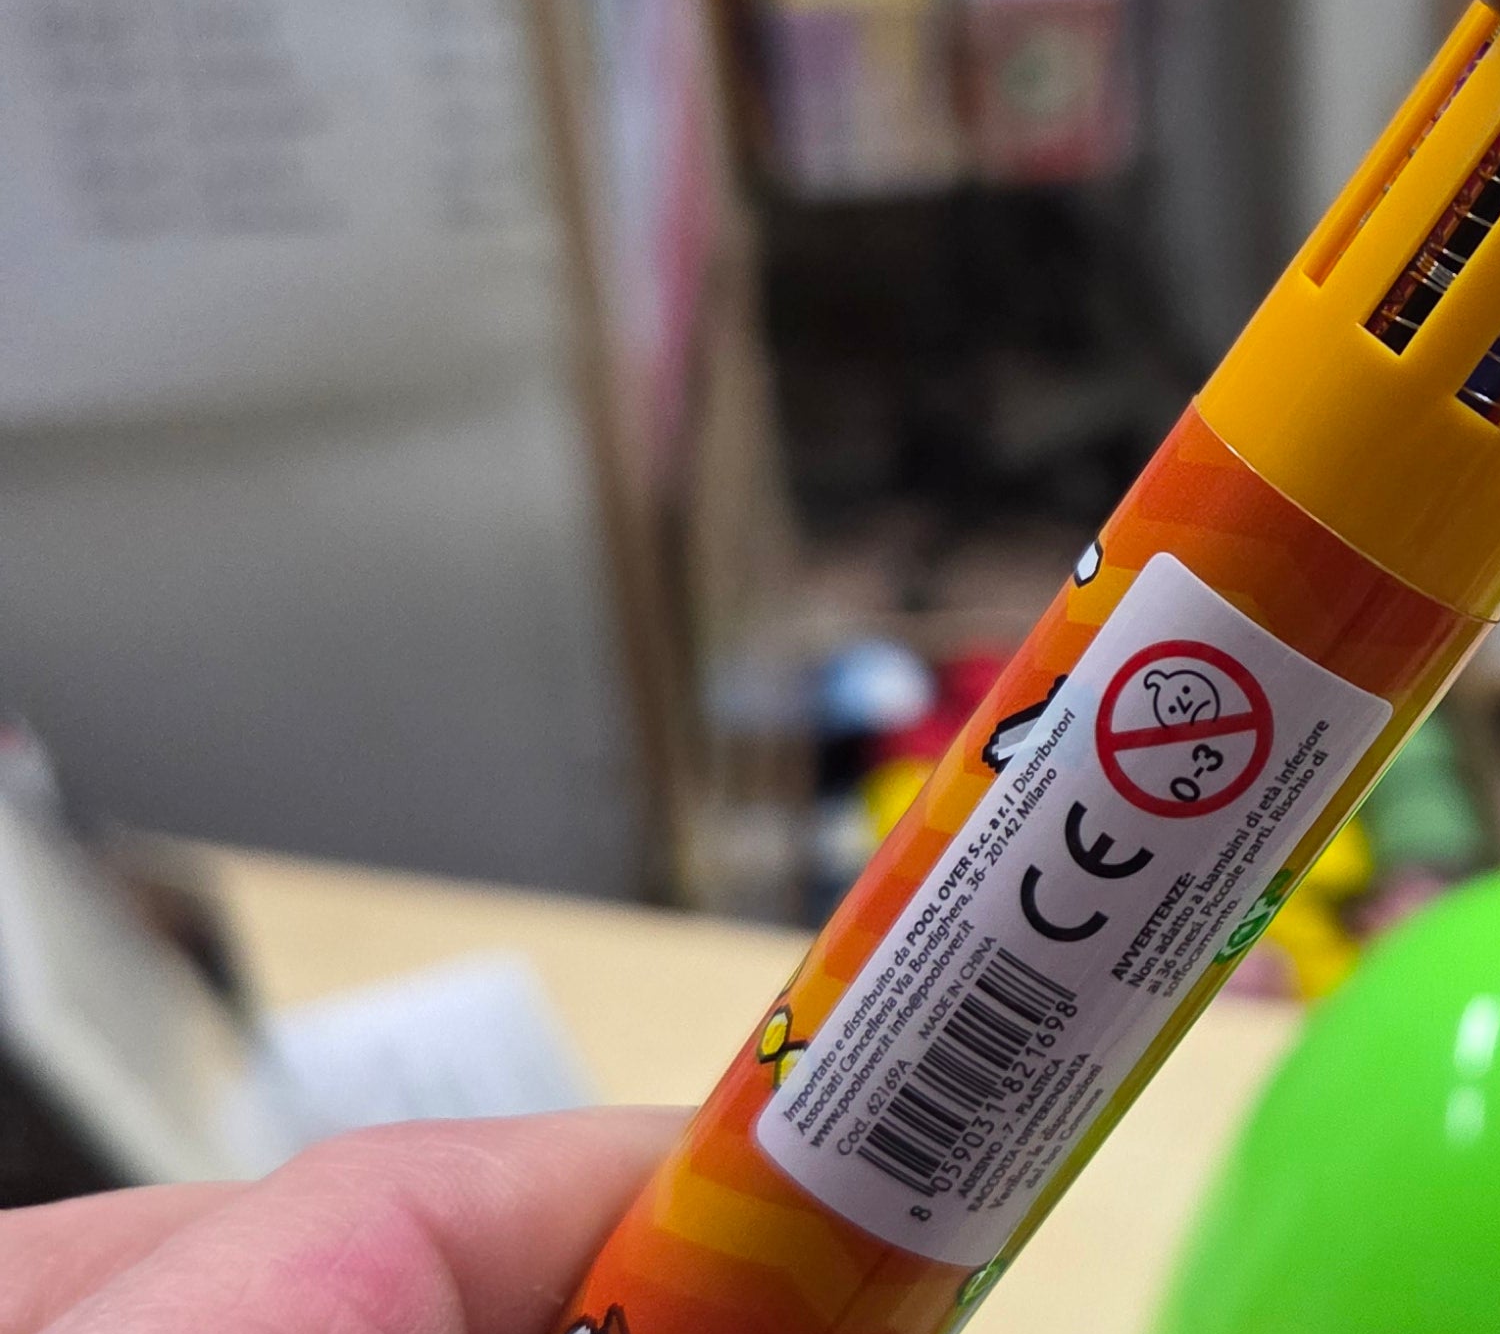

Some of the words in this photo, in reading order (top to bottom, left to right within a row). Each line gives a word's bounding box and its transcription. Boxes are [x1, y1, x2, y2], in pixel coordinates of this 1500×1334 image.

[1169, 743, 1223, 807] 0-3
[1258, 786, 1282, 810] età
[1274, 720, 1328, 784] inferiore
[1195, 828, 1249, 892] bambini
[1246, 810, 1262, 828] di
[783, 1051, 836, 1121] Importato
[835, 1039, 844, 1050] e
[843, 967, 895, 1039] distribuito
[894, 946, 910, 966] da
[905, 903, 941, 946] POOL
[938, 856, 972, 900] OVER
[989, 818, 1000, 830] a
[1012, 708, 1075, 793] Distributori
[1019, 801, 1154, 942] CE
[1146, 978, 1162, 994] ai
[1155, 959, 1176, 978] 36
[1173, 920, 1207, 956] mesi.
[1199, 864, 1245, 916] Piccole
[1241, 825, 1275, 863] parti.
[1268, 768, 1314, 821] Rischio
[1312, 749, 1327, 766] di
[1191, 894, 1203, 904] a
[797, 1070, 843, 1135] Associati
[839, 996, 897, 1072] Cancelleria
[890, 973, 913, 995] Via
[908, 894, 972, 973] Bordighera,
[984, 817, 1021, 866] 20142
[1016, 768, 1056, 819] Milano
[1111, 872, 1195, 980] AVVERTENZE:
[1127, 956, 1158, 987] Non
[1154, 906, 1194, 954] adatto
[809, 1034, 893, 1147] www.poolover.it
[887, 920, 974, 1035] info@poolover.it
[836, 1117, 871, 1155] Cod.
[866, 1059, 911, 1115] 62169A
[918, 995, 953, 1039] MADE
[946, 979, 963, 997] IN
[959, 936, 996, 980] CHINA
[909, 1205, 931, 1221] 8
[1001, 1000, 1077, 1093] 821698
[957, 1141, 1002, 1197] ADESIVO
[1002, 1122, 1013, 1133] 7
[1015, 1059, 1063, 1114] PLASTICA
[1015, 1054, 1089, 1145] DIFFERENZIATA
